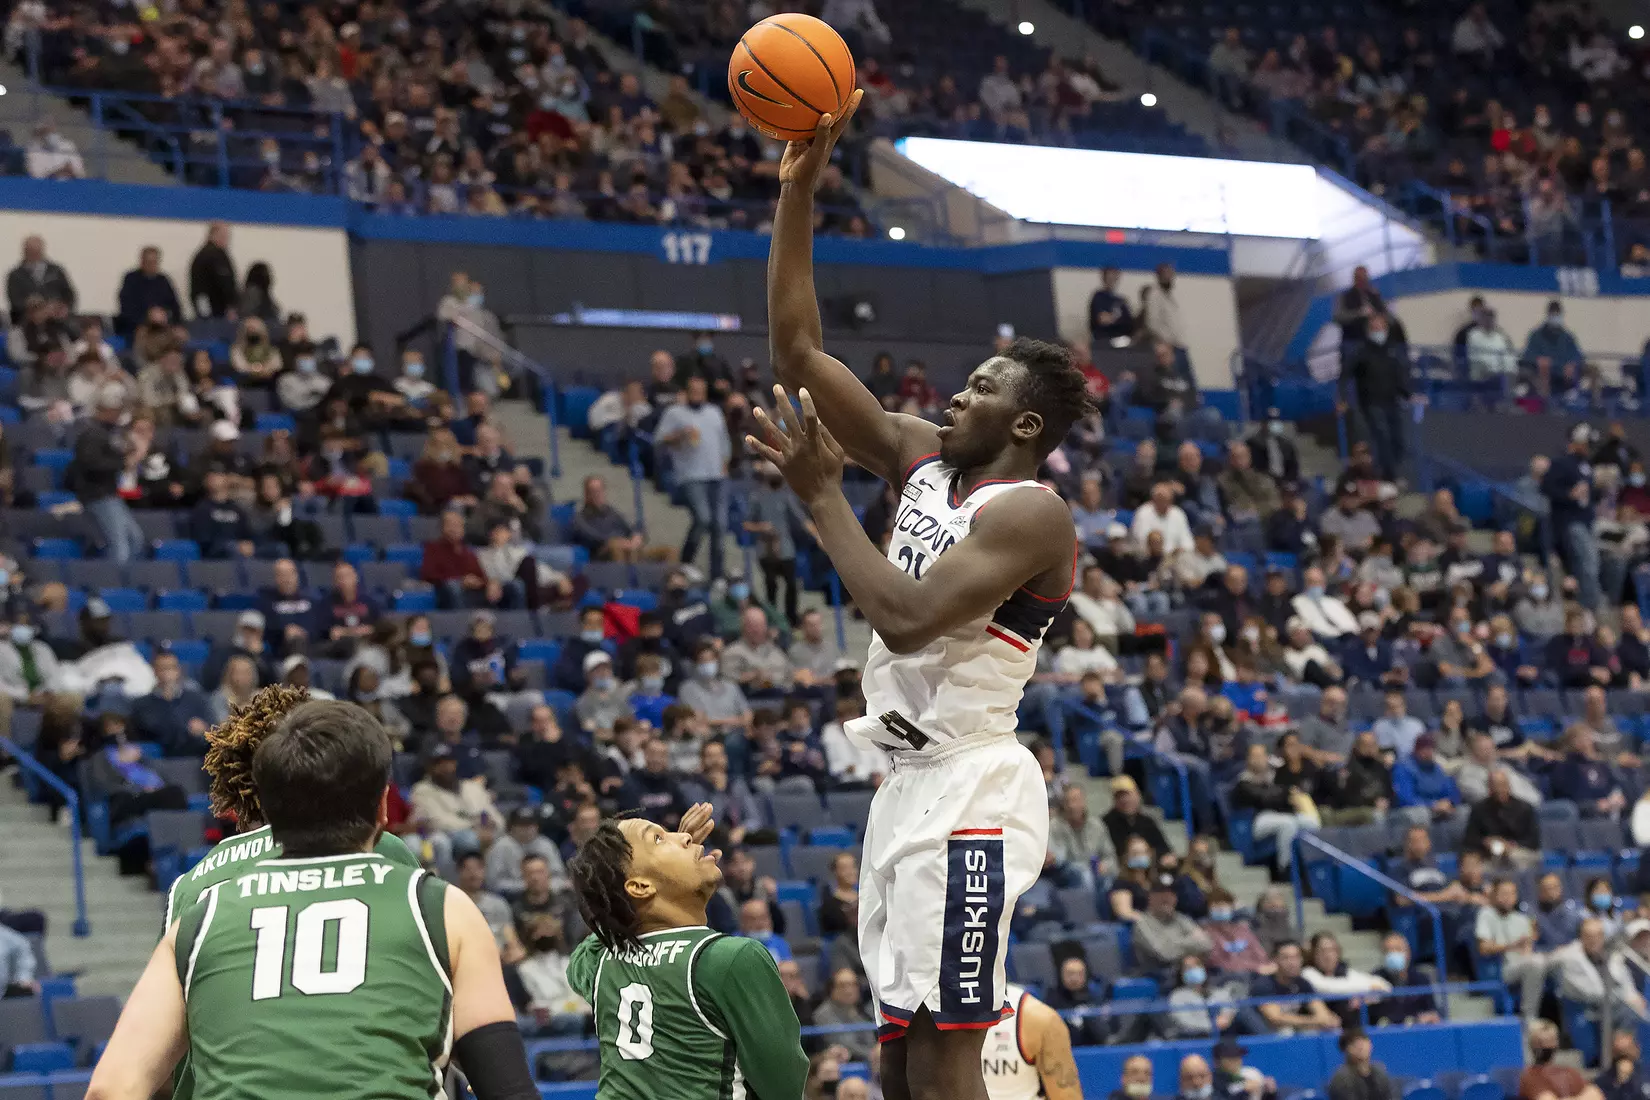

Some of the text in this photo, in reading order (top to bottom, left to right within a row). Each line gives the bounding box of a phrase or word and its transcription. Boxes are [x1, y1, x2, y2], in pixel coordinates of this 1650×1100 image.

[662, 233, 712, 265] 117
[191, 835, 280, 881] AKUWOV
[236, 863, 394, 898] TINSLEY
[250, 898, 370, 1001] 10
[959, 849, 988, 1004] HUSKIES
[615, 982, 655, 1061] 0
